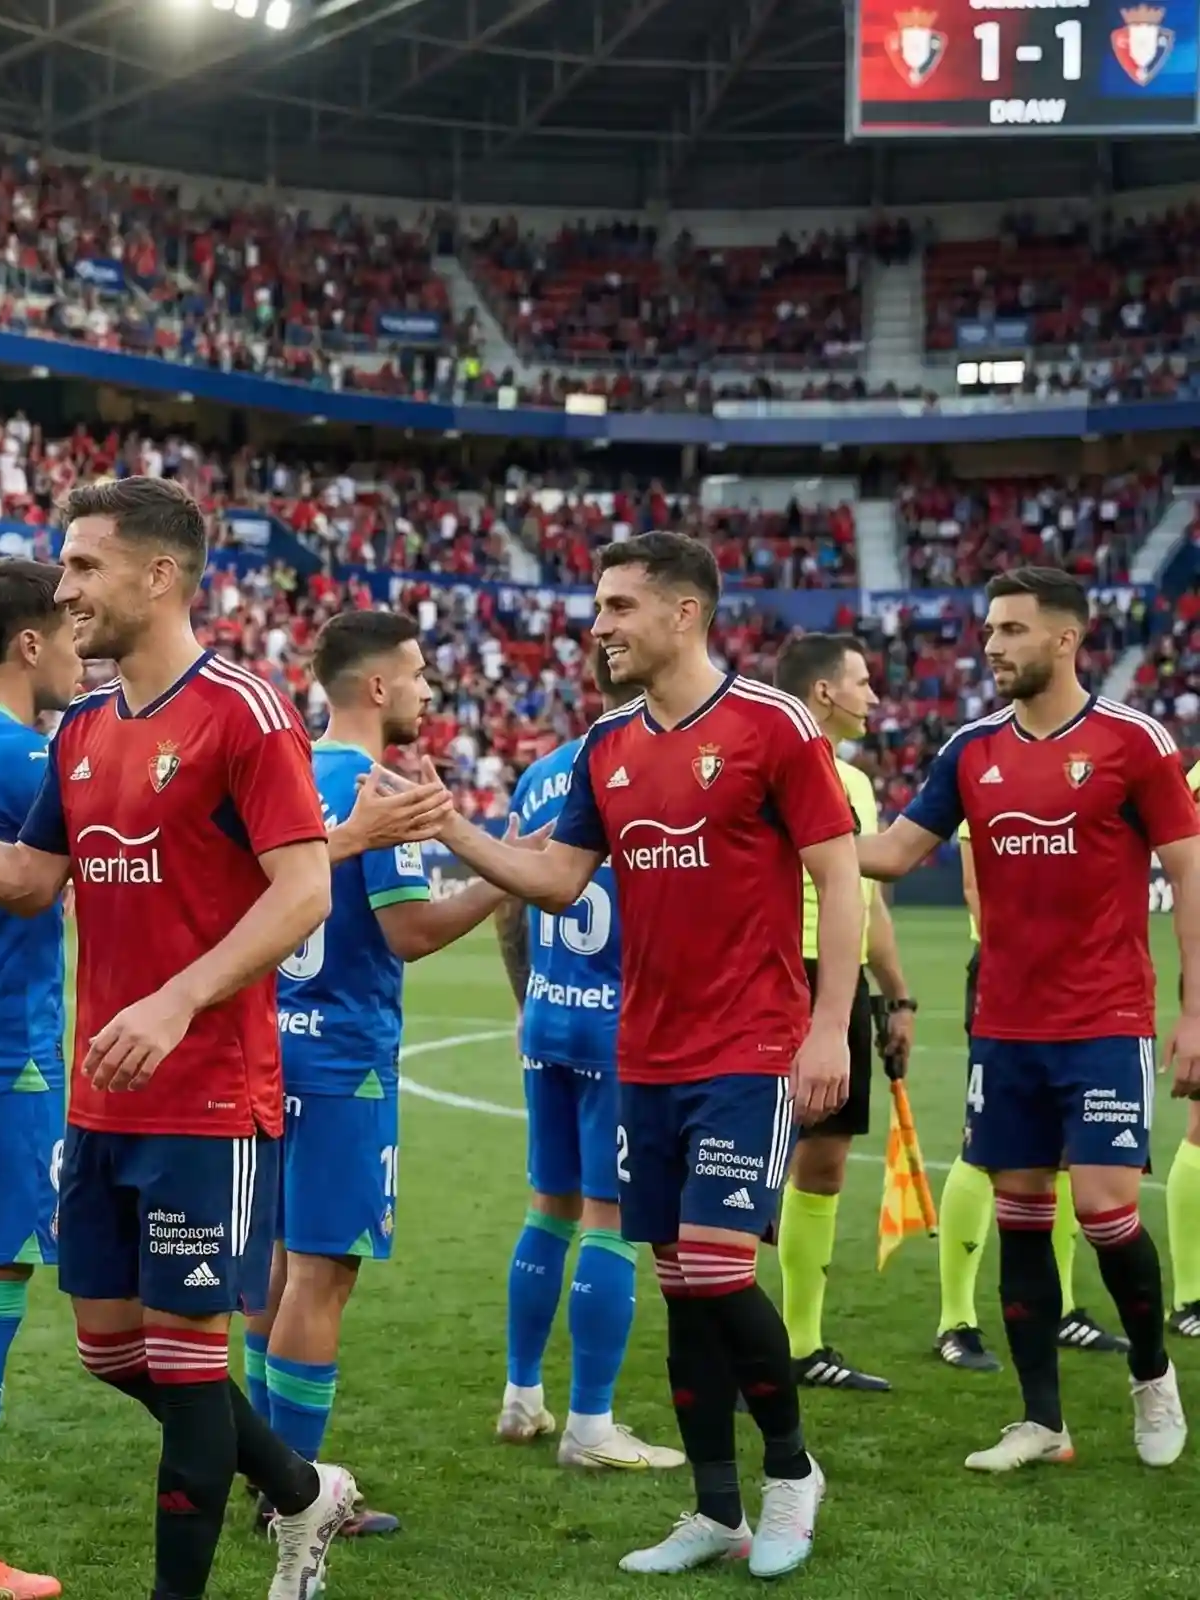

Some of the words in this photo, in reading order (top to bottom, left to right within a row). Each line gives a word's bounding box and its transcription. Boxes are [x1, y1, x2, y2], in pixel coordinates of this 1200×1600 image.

[974, 21, 1000, 82] 1
[1055, 20, 1082, 81] 1
[989, 98, 1066, 124] DRAW
[968, 1064, 985, 1114] 4
